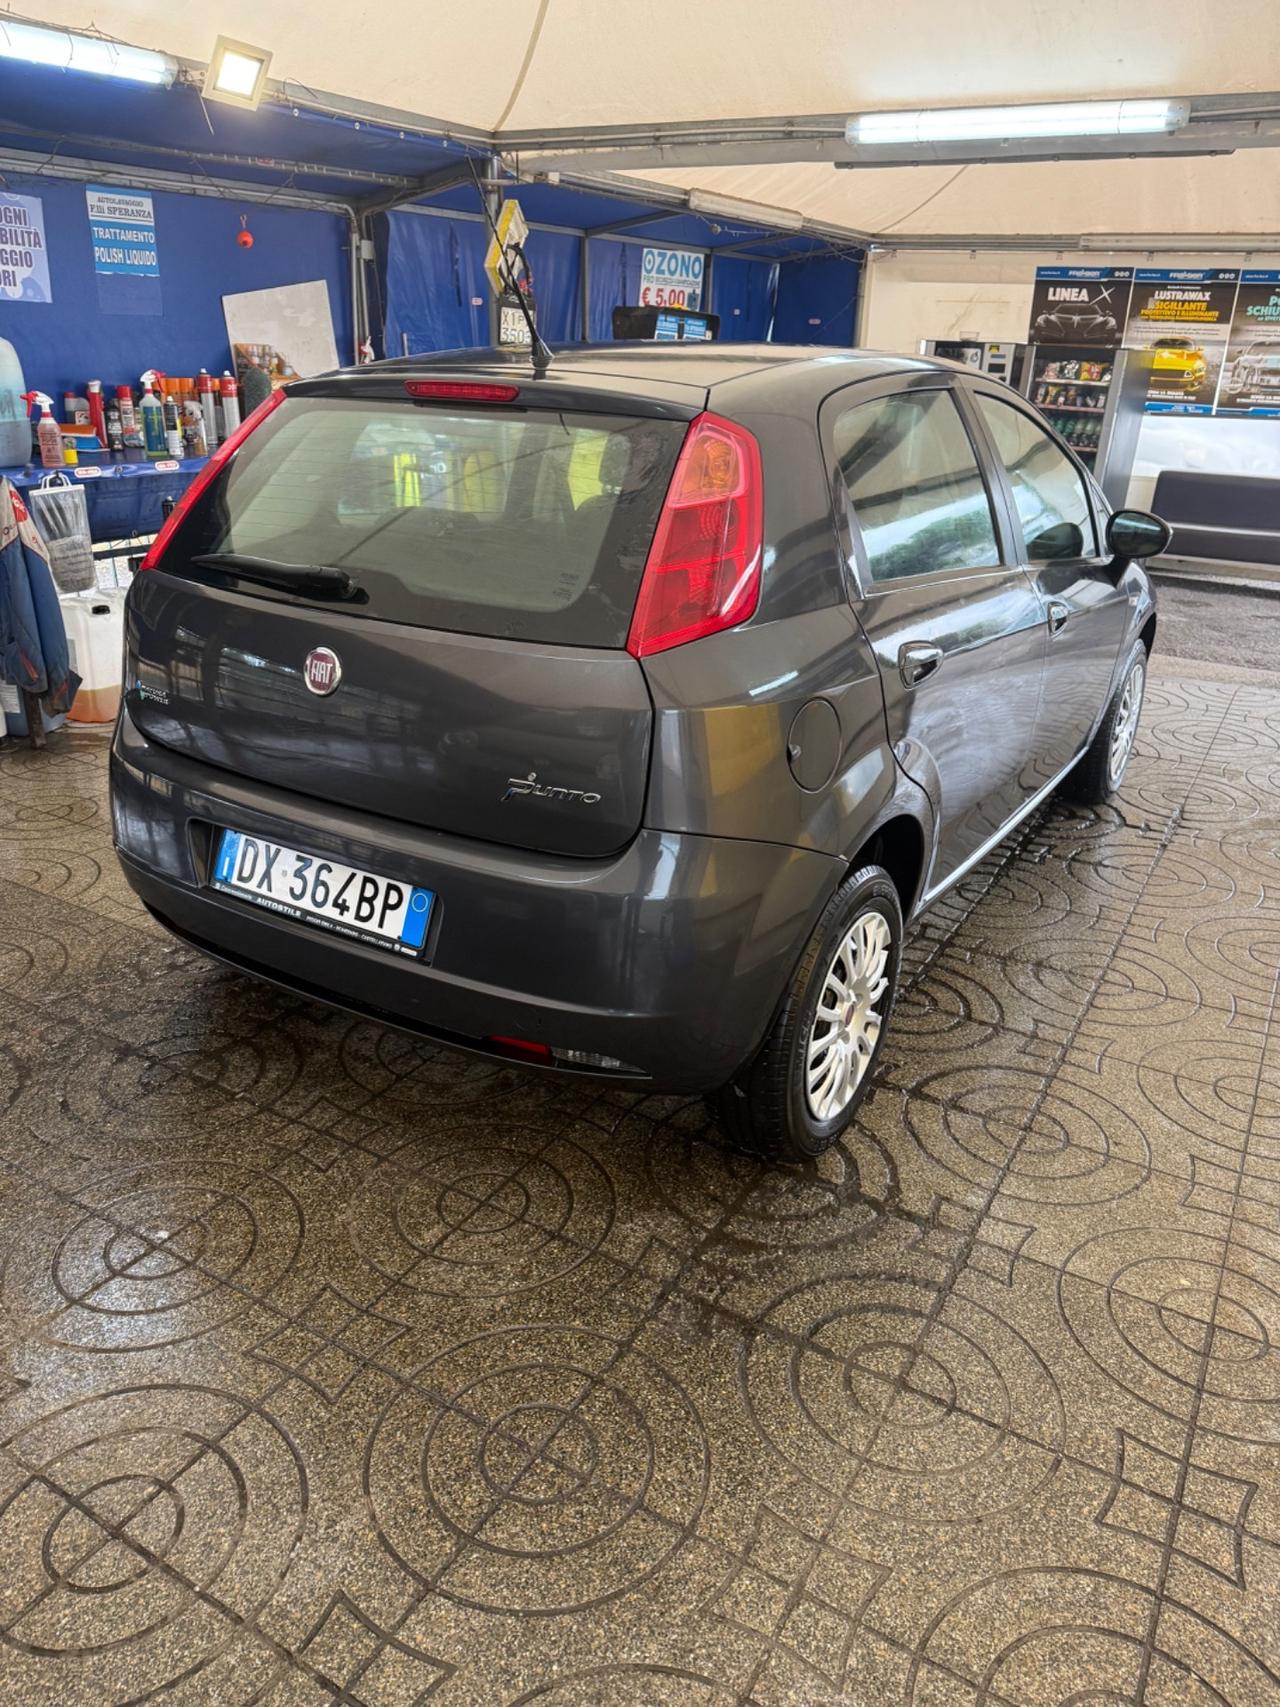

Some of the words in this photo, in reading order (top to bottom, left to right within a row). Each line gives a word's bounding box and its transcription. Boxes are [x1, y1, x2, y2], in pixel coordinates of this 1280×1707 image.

[107, 206, 153, 219] SPERANZA
[92, 227, 155, 243] TRATTAMENTO
[94, 246, 124, 263] POLISH
[124, 249, 157, 266] LIQUIDO
[643, 249, 702, 279] OZONO
[642, 286, 651, 306] €
[1047, 287, 1090, 302] LINEA
[1154, 290, 1211, 301] LUSTRAWAX
[1154, 300, 1208, 311] SIGILLANTE
[311, 660, 333, 684] FIAT
[236, 838, 281, 893] DX
[289, 854, 404, 929] 364BP
[256, 897, 302, 917] AUTOSTILE
